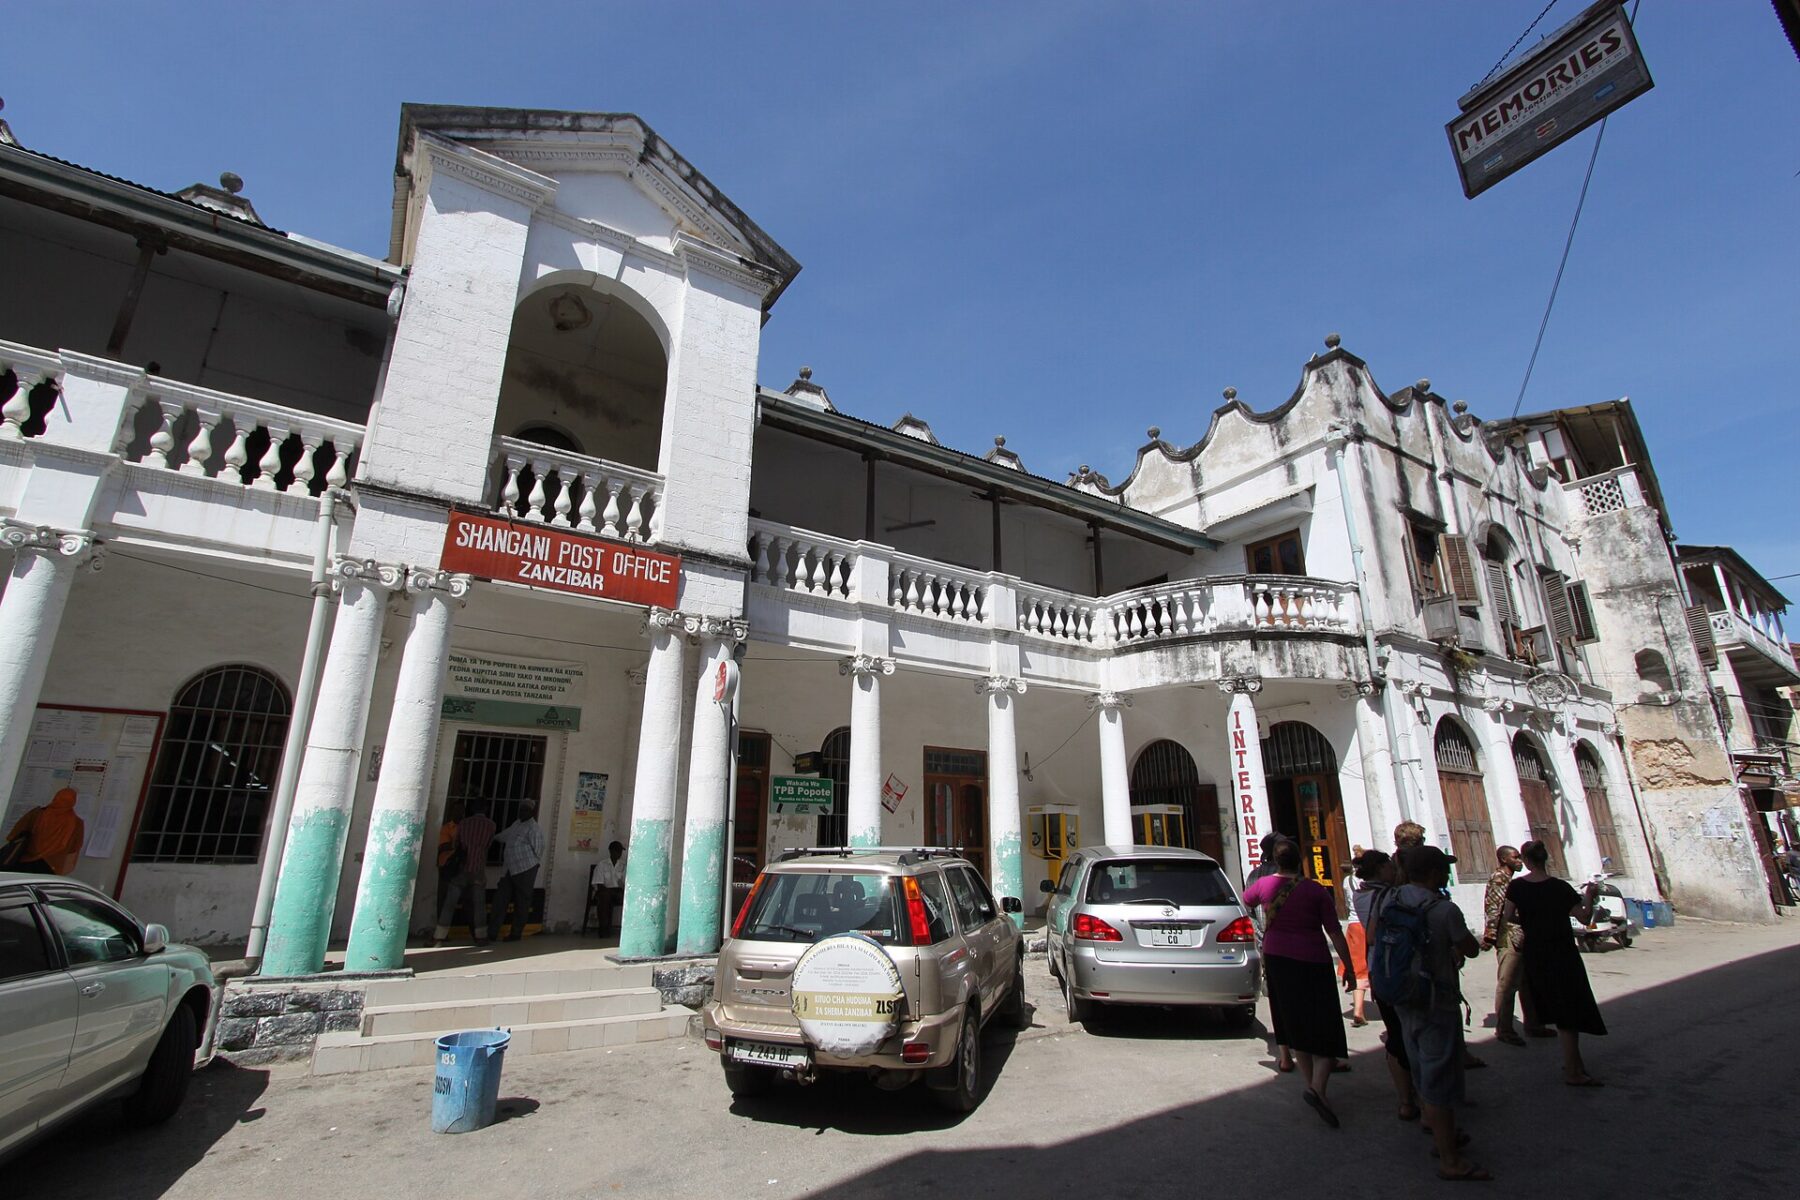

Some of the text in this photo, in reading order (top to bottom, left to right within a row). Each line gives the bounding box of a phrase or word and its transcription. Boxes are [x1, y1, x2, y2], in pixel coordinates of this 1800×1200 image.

[1458, 28, 1622, 151] MEMORIES
[1524, 84, 1565, 113] ZANZIBAR
[456, 522, 671, 583] SHANGANI POST OFFICE
[518, 561, 604, 590] ZANZIBAR
[469, 656, 477, 664] YA
[479, 658, 491, 666] TPB
[493, 661, 517, 669] POPOTE
[565, 668, 584, 677] KUTOA
[472, 667, 498, 677] KUPITIA
[499, 670, 516, 679] SIMU
[516, 672, 533, 681] YAKO
[534, 674, 542, 682] YA
[454, 675, 473, 683] SASA
[474, 677, 516, 688] INAPATIKANA
[517, 681, 539, 690] KATIKA
[541, 683, 557, 691] OFISI
[464, 686, 490, 695] SHIRIKA
[502, 689, 522, 697] POSTA
[523, 692, 553, 700] TANZANIA
[774, 785, 831, 797] TPB Popote
[1232, 711, 1262, 872] INTERNET
[832, 995, 845, 1005] CHA
[876, 999, 895, 1015] ZLS
[815, 1007, 824, 1016] ZA
[748, 1044, 793, 1062] Z 243 DF
